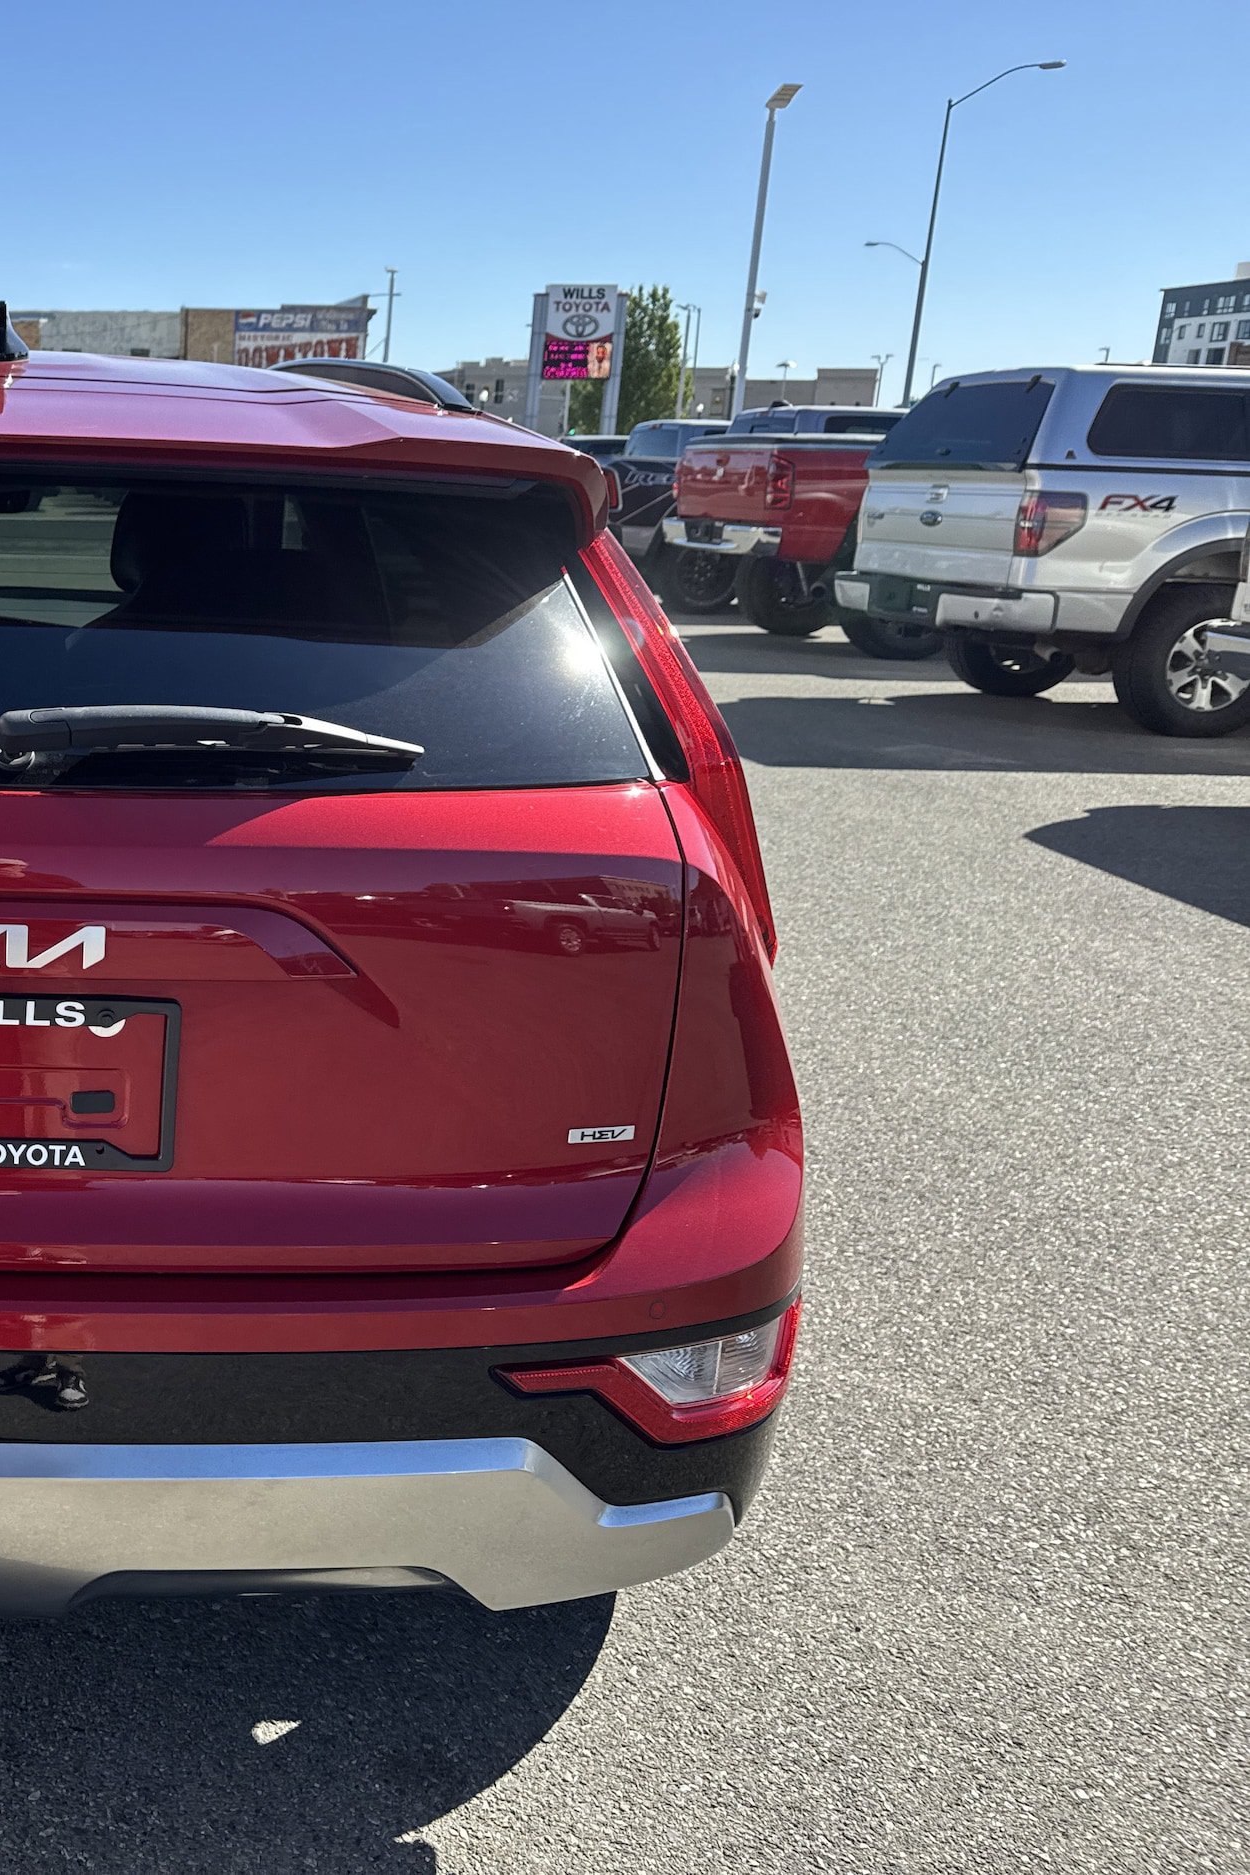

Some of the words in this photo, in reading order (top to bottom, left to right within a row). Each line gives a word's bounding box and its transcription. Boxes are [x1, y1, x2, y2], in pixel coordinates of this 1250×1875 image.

[562, 287, 606, 300] WILLS
[554, 301, 611, 313] TOYOTA
[258, 313, 313, 328] PEPSI
[1098, 494, 1179, 512] FX4
[581, 1128, 627, 1141] HEV
